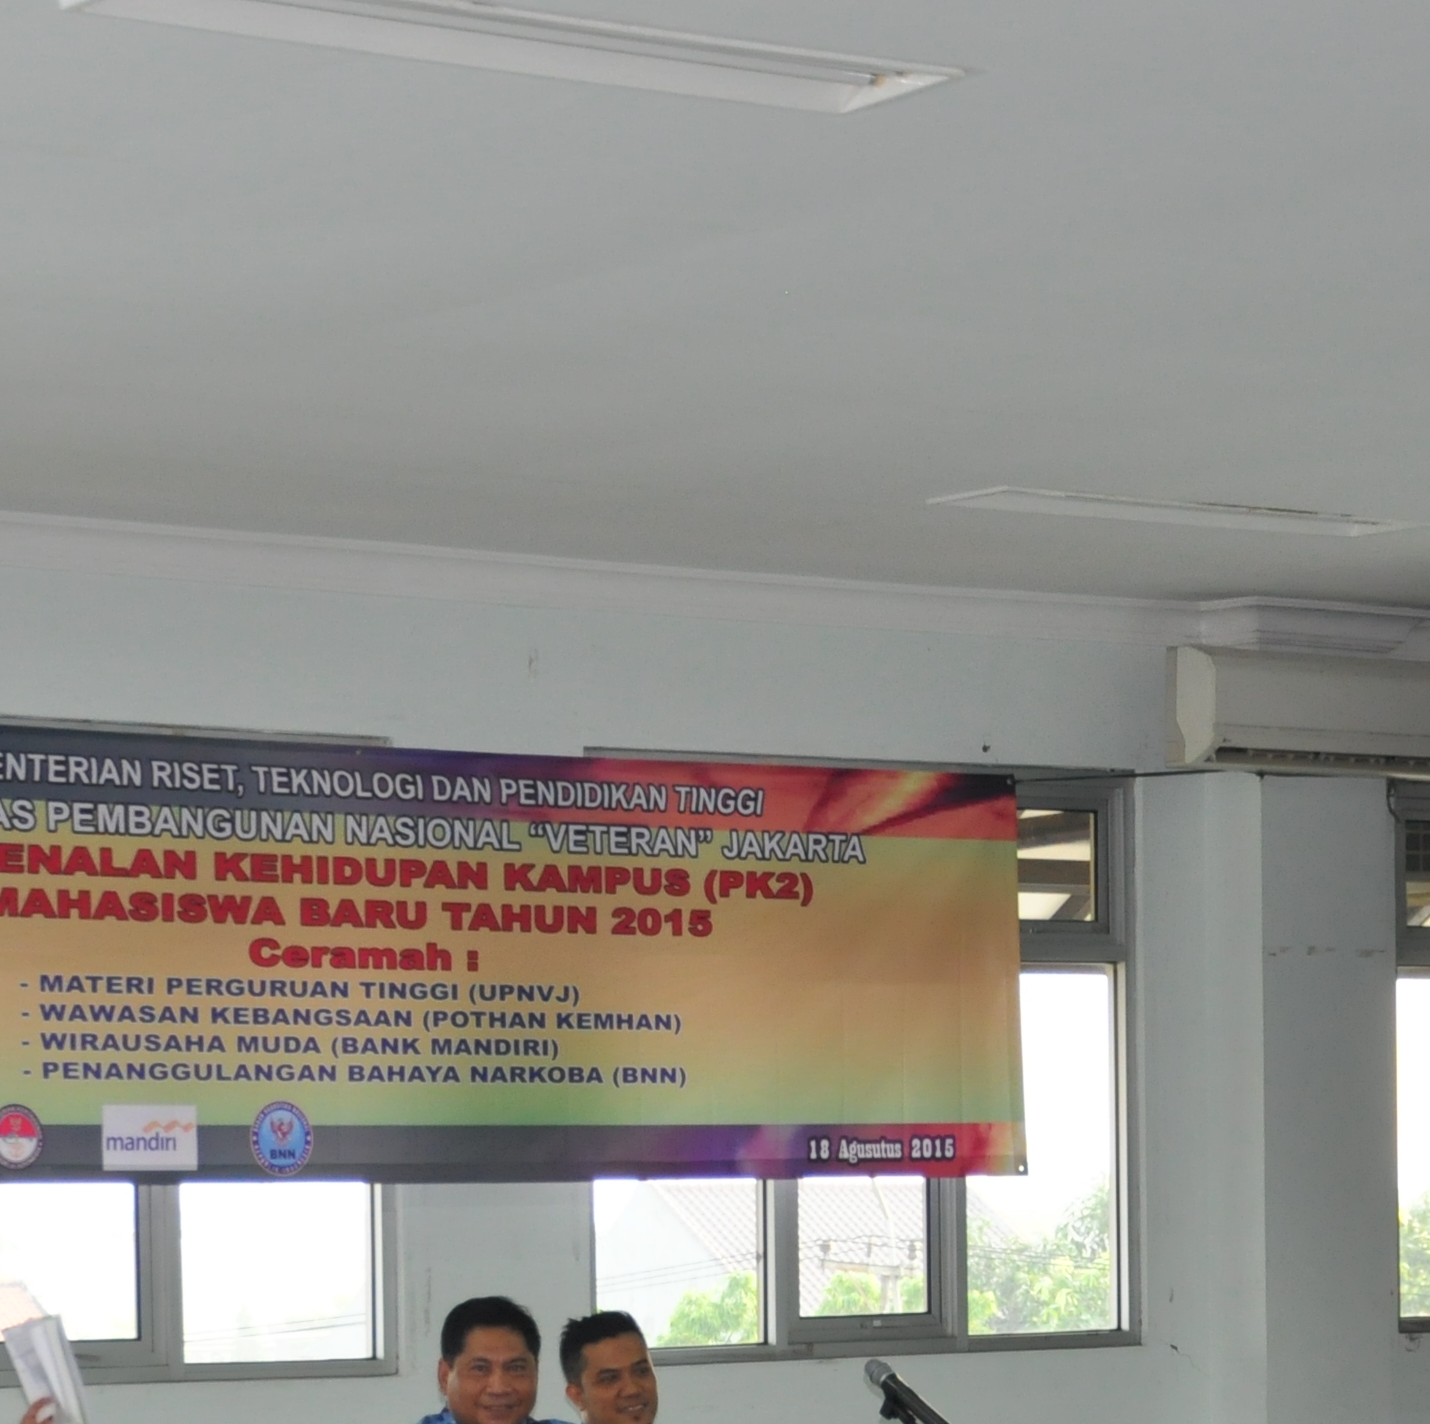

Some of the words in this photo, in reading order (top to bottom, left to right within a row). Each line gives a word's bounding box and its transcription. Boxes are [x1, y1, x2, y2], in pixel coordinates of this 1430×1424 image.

[151, 760, 245, 797] RISET,
[251, 765, 424, 801] TEKNOLOGI
[432, 775, 492, 804] DAN
[500, 778, 668, 812] PENDIDIKAN
[675, 785, 764, 817] TINGGI
[47, 803, 335, 844] PEMBANGUNAN
[344, 816, 521, 852] NASIONAL
[722, 831, 866, 864] JAKARTA
[214, 852, 488, 891] KEHIDUPAN
[503, 863, 691, 896] KAMPUS
[704, 869, 814, 907] (PK2)
[299, 897, 428, 931] BARU
[442, 902, 598, 935] TAHUN
[611, 906, 714, 938] 2015
[248, 937, 452, 971] Ceramah
[39, 974, 155, 996] MATERI
[166, 977, 350, 999] PERGURUAN
[359, 982, 459, 1001] TINGGI
[469, 983, 580, 1007] (UPNVJ)
[39, 1003, 200, 1024] WAWASAN
[211, 1006, 413, 1027] KEBANGSAAN
[423, 1010, 546, 1032] (POTHAN
[556, 1012, 682, 1036] KEMHAN)
[40, 1032, 227, 1053] WIRAUSAHA
[236, 1035, 322, 1055] MUDA
[330, 1036, 421, 1059] (BANK
[431, 1038, 560, 1061] MANDIRI)
[42, 1061, 337, 1082] PENANGGULANGAN
[348, 1064, 461, 1083] BAHAYA
[470, 1066, 604, 1084] NARKOBA
[612, 1067, 687, 1088] (BNN)
[106, 1131, 177, 1152] mandiri
[269, 1149, 296, 1160] BNN
[809, 1138, 830, 1160] 18
[838, 1138, 903, 1164] Agusutus
[911, 1137, 954, 1159] 2015
